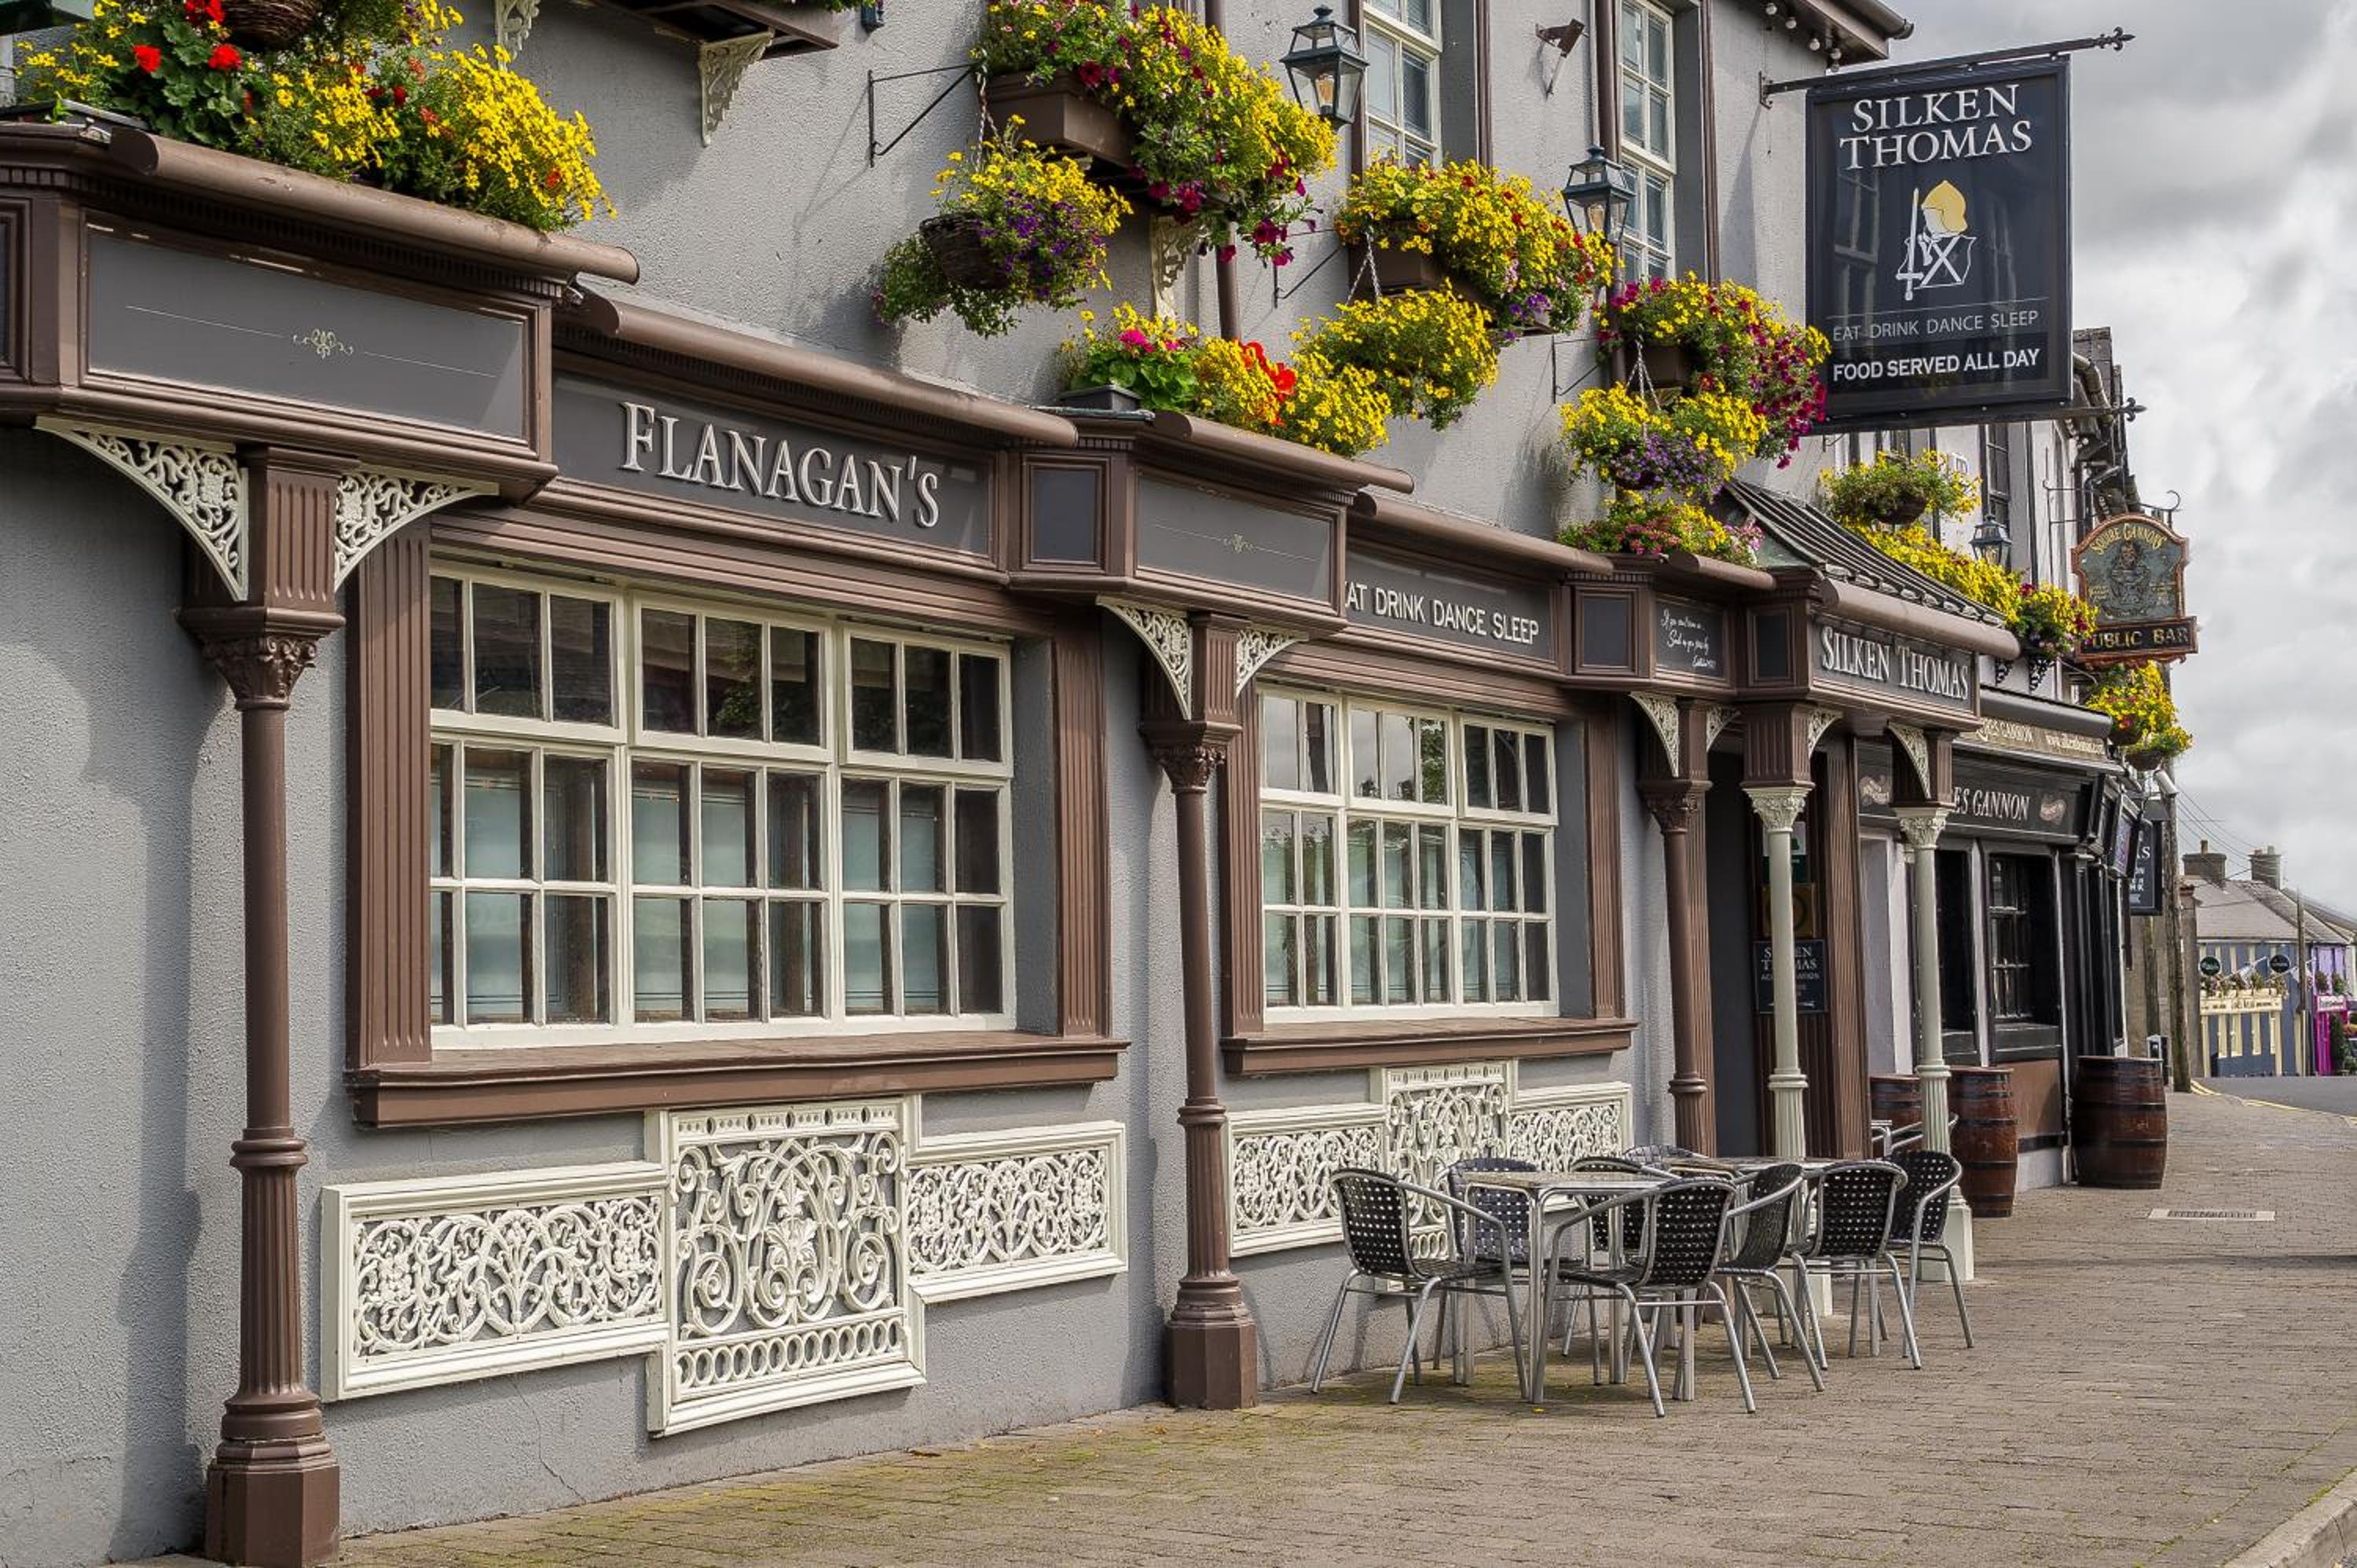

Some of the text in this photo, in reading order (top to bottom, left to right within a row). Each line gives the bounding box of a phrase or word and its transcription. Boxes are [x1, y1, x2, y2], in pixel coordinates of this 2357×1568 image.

[1851, 84, 2021, 134] SILKEN
[1839, 120, 2033, 170] THOMAS
[1833, 310, 2039, 343] EAT DRINK DANCE SLEEP
[1833, 347, 2041, 383] FOOD SERVED ALL DAY
[619, 401, 940, 529] FLANAGAN'S
[1344, 581, 1539, 645] AT DRINK DANCE SLEEP
[2092, 627, 2189, 649] UBLIC BAR
[1821, 625, 1968, 701] SILKEN THOMAS
[1972, 789, 2031, 821] GANNON
